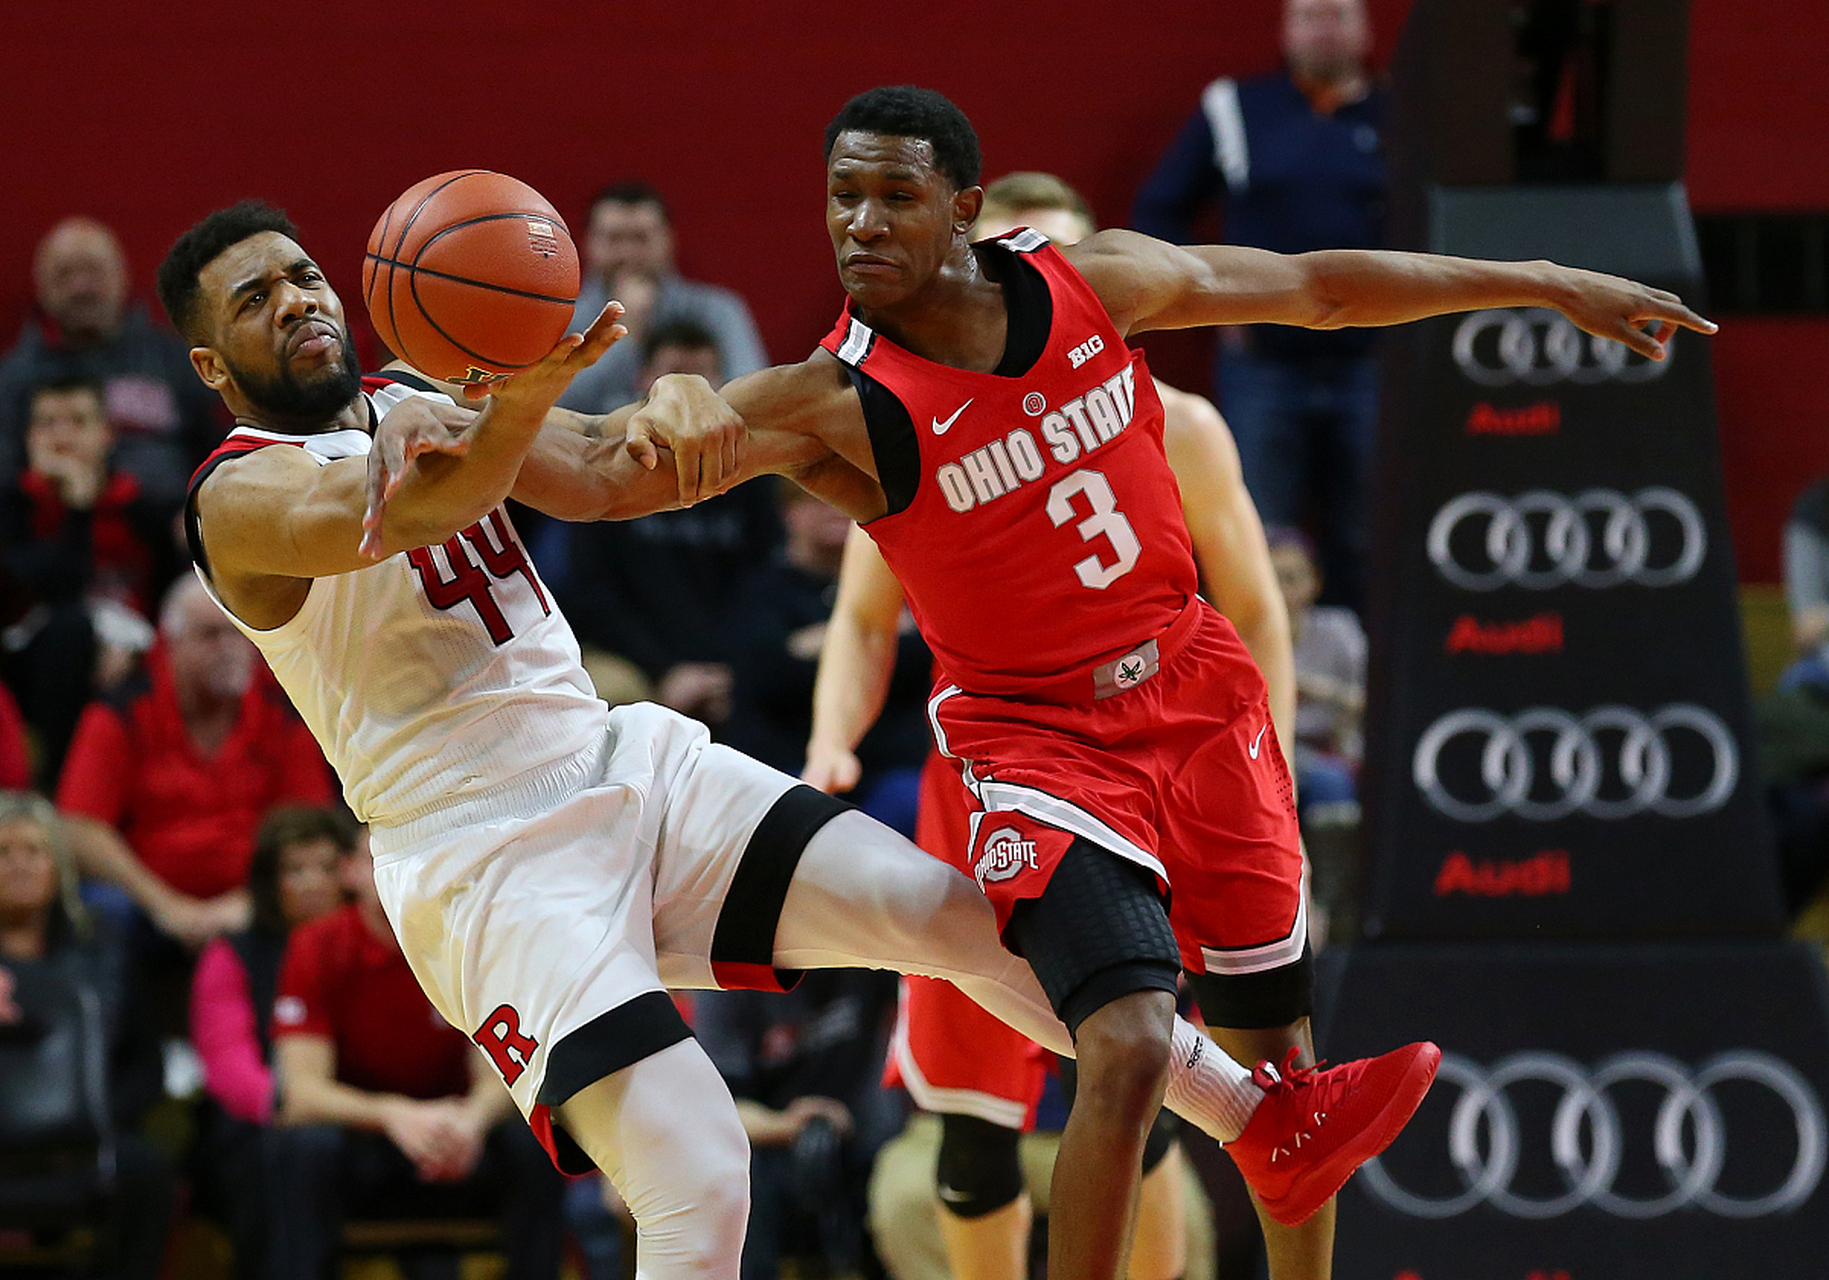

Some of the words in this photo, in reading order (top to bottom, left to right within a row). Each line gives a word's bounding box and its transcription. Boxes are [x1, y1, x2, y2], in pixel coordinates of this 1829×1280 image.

[1467, 401, 1560, 435] Audi
[936, 427, 1046, 513] OHIO
[1045, 468, 1143, 590] 3
[406, 507, 552, 647] 44
[1445, 612, 1563, 653] Audi
[996, 840, 1039, 870] STATE
[1434, 849, 1571, 896] Audi
[472, 1003, 540, 1088] R
